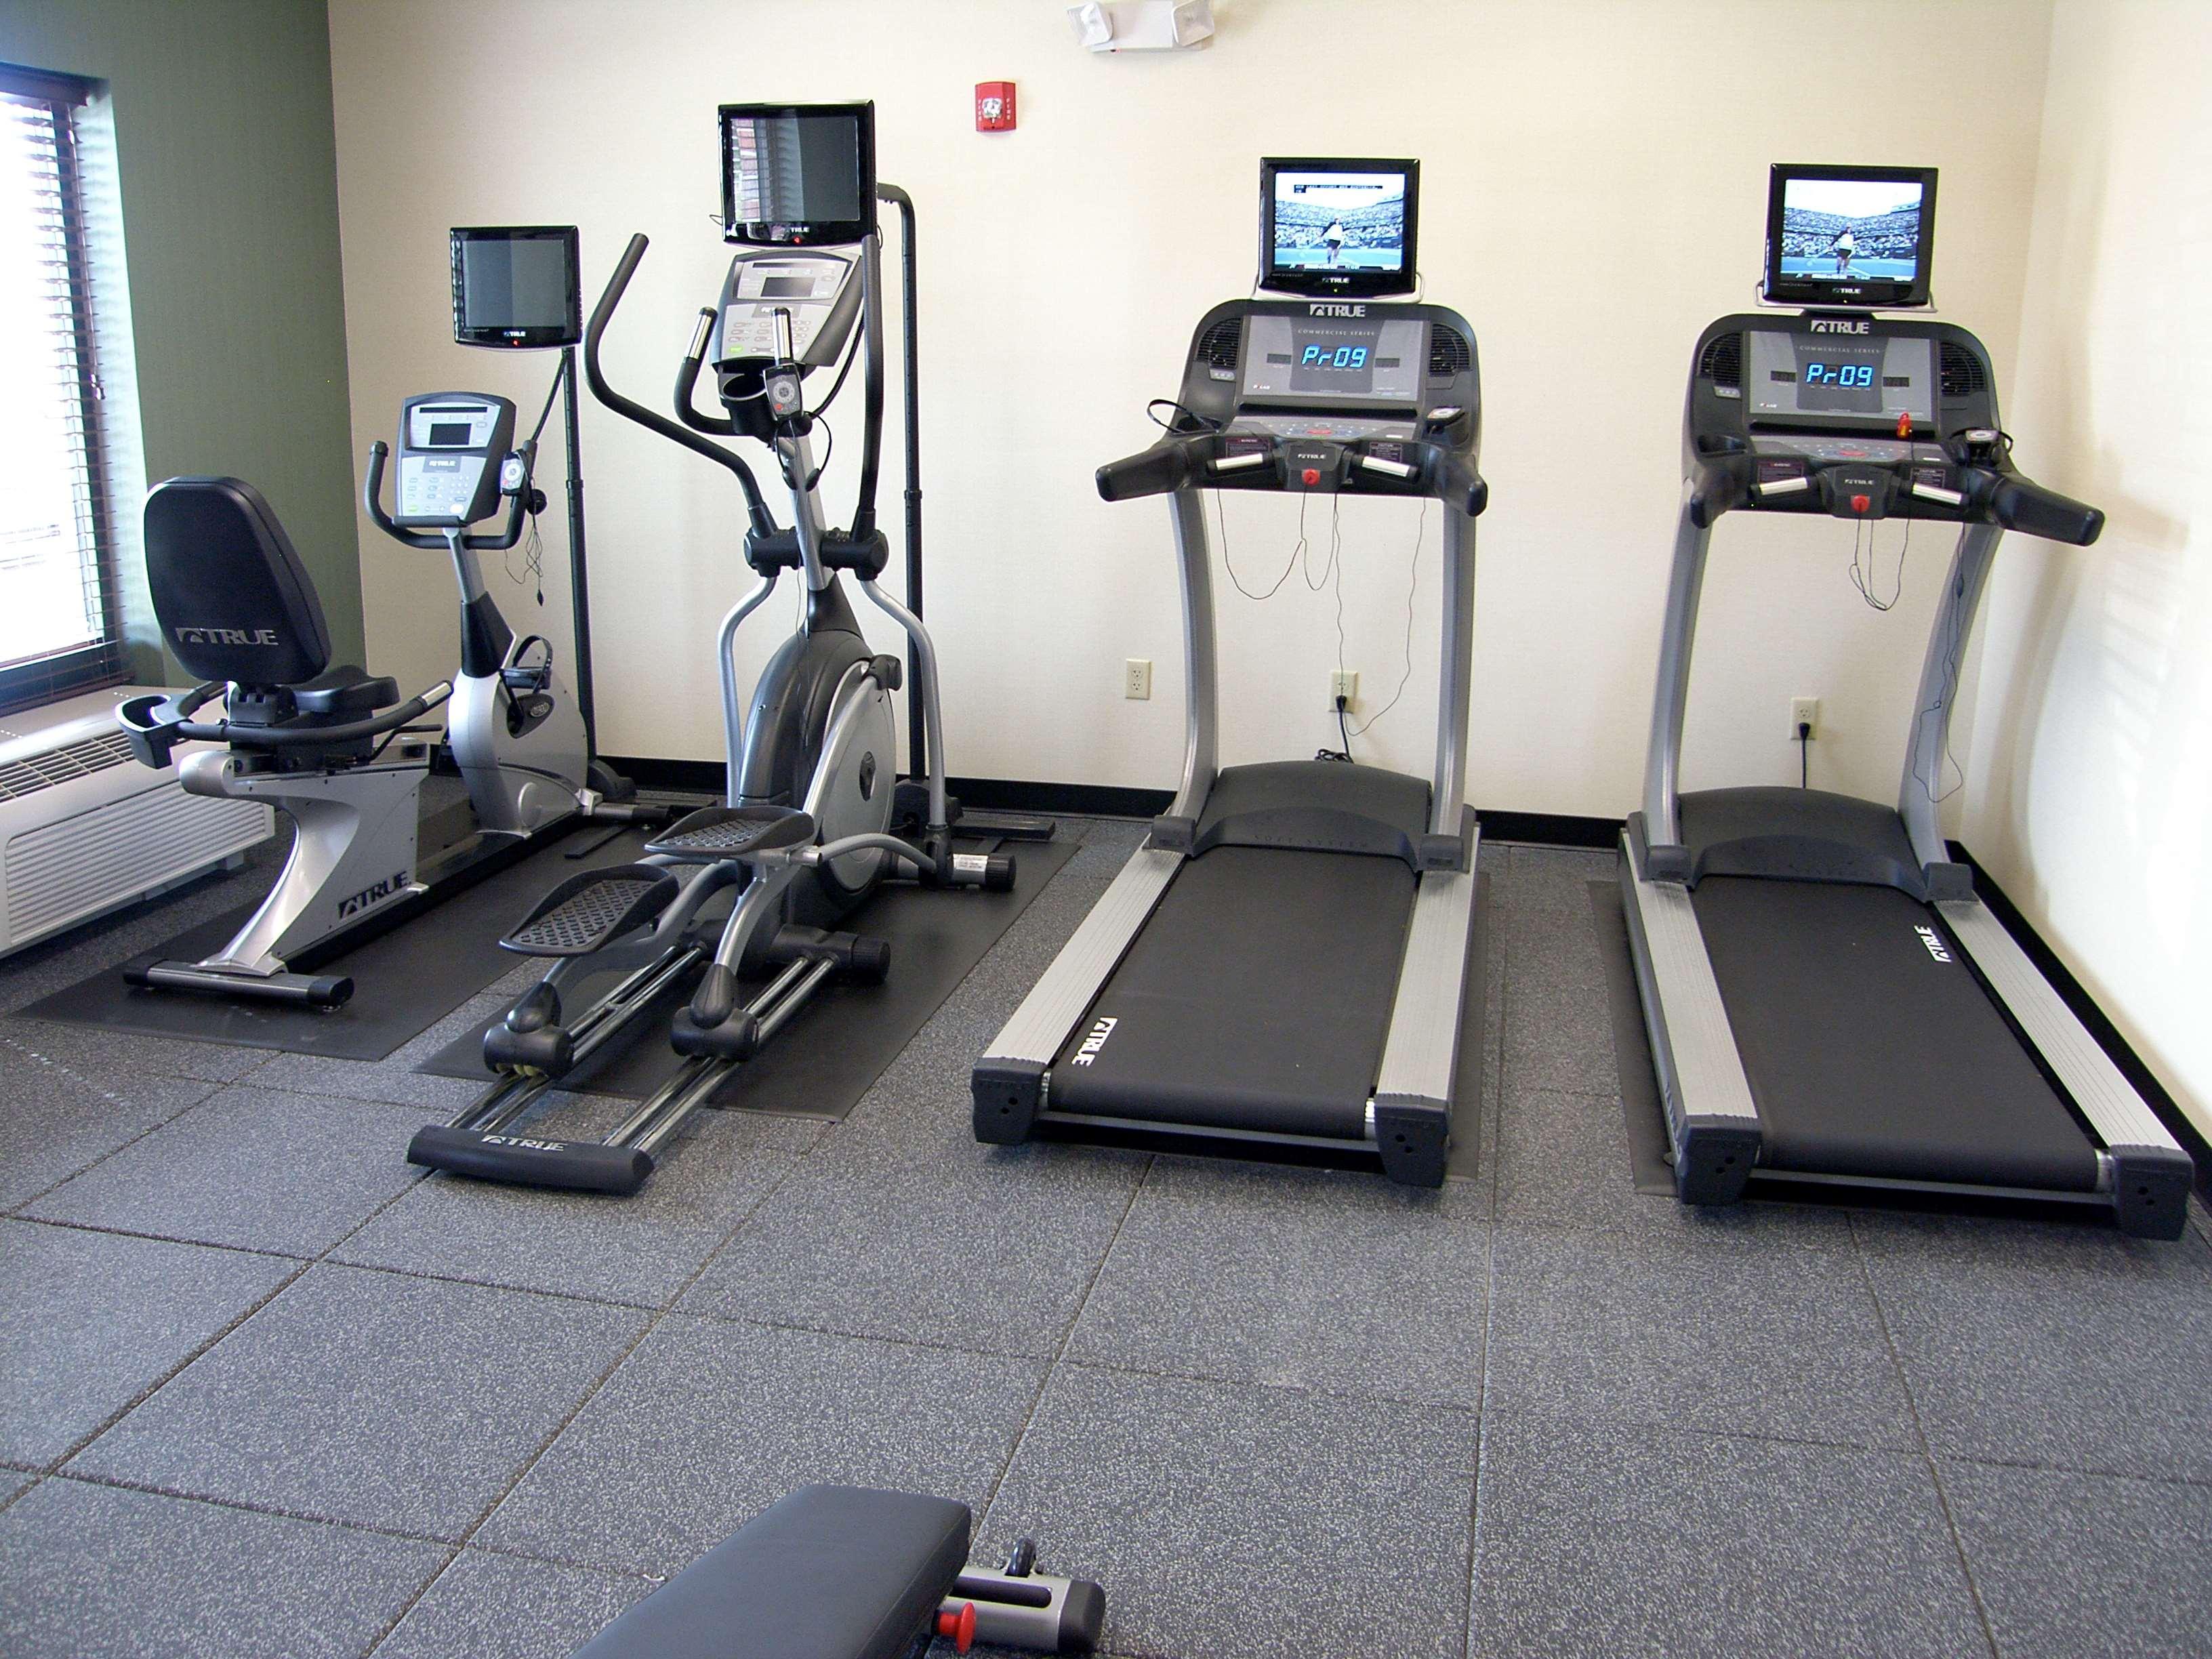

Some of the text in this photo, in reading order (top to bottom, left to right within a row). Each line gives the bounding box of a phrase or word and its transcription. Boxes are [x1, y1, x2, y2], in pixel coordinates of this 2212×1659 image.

[1325, 304, 1366, 318] TRUE
[1297, 328, 1347, 336] COMMERCIAL
[1826, 321, 1870, 334] TRUE
[1301, 344, 1368, 369] Pr09
[1799, 345, 1851, 354] COMMERCIAL
[1805, 363, 1873, 386] Pr09
[202, 628, 279, 645] TRUE
[359, 870, 409, 908] TRUE
[1914, 925, 1945, 952] TRUE
[1071, 1029, 1111, 1067] TRUE
[508, 1136, 569, 1152] TRUE
